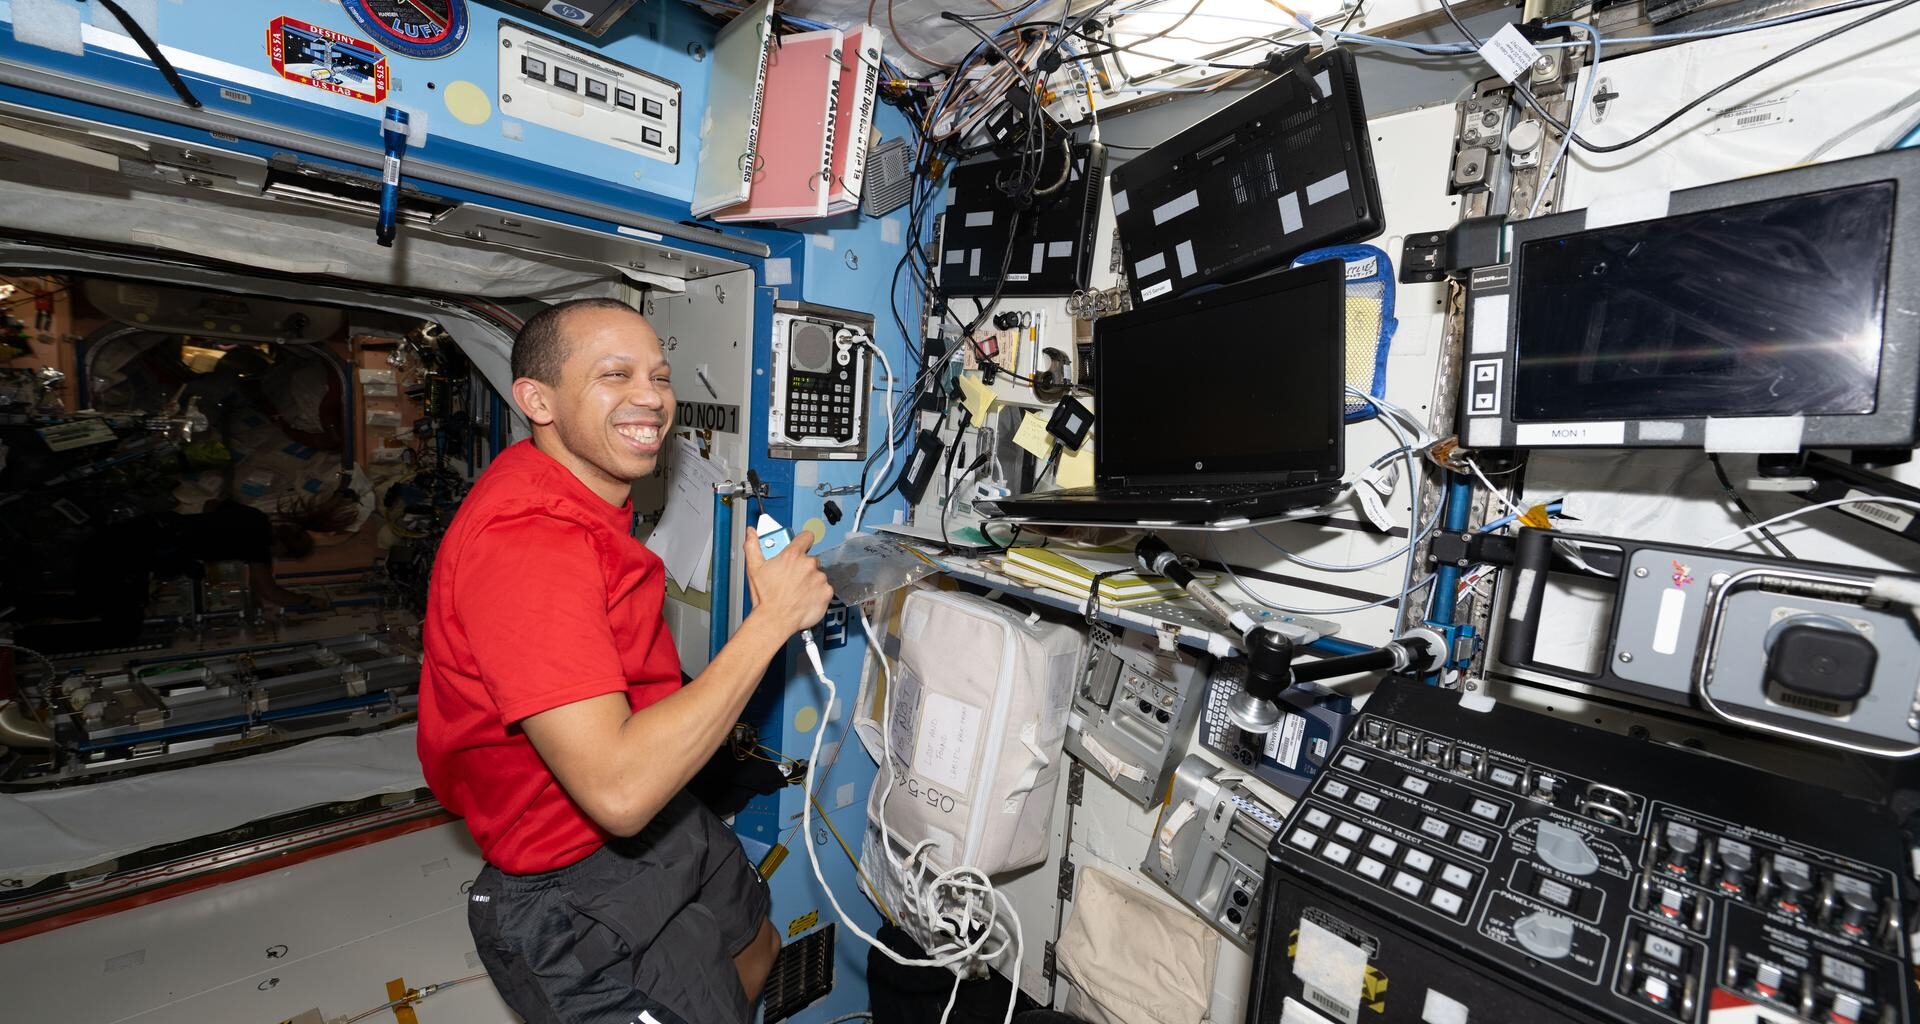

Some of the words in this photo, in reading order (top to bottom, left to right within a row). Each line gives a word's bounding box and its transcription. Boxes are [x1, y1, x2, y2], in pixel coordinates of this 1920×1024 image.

[310, 25, 355, 46] DESTINY
[392, 18, 445, 38] LUFA
[312, 80, 330, 90] U.S.
[332, 86, 352, 96] LAB
[865, 64, 878, 97] EMER:
[822, 79, 840, 182] WARNING
[743, 126, 758, 184] COMPUTERS
[677, 402, 692, 427] TO
[695, 404, 726, 431] NOD
[730, 407, 737, 432] 1
[1552, 429, 1577, 437] MON
[825, 601, 847, 645] RT
[1457, 739, 1487, 752] CAMERA
[1488, 748, 1527, 763] COMMAND
[1393, 760, 1425, 774] MONITOR
[1426, 771, 1453, 784] SELECT
[1495, 773, 1513, 781] AUTO
[1380, 788, 1418, 805] MULTIPLEX
[1421, 803, 1438, 813] UNIT
[1361, 817, 1393, 834] CAMERA
[1394, 830, 1422, 845] SELECT
[1549, 812, 1571, 823] JOINT
[1572, 819, 1605, 834] SELECT
[1744, 826, 1786, 842] BRAKES
[1531, 862, 1553, 874] RWS
[1554, 870, 1592, 889] STATUS
[1651, 875, 1677, 889] AUTO
[1653, 942, 1674, 957] ON
[1642, 962, 1667, 979] SAFE
